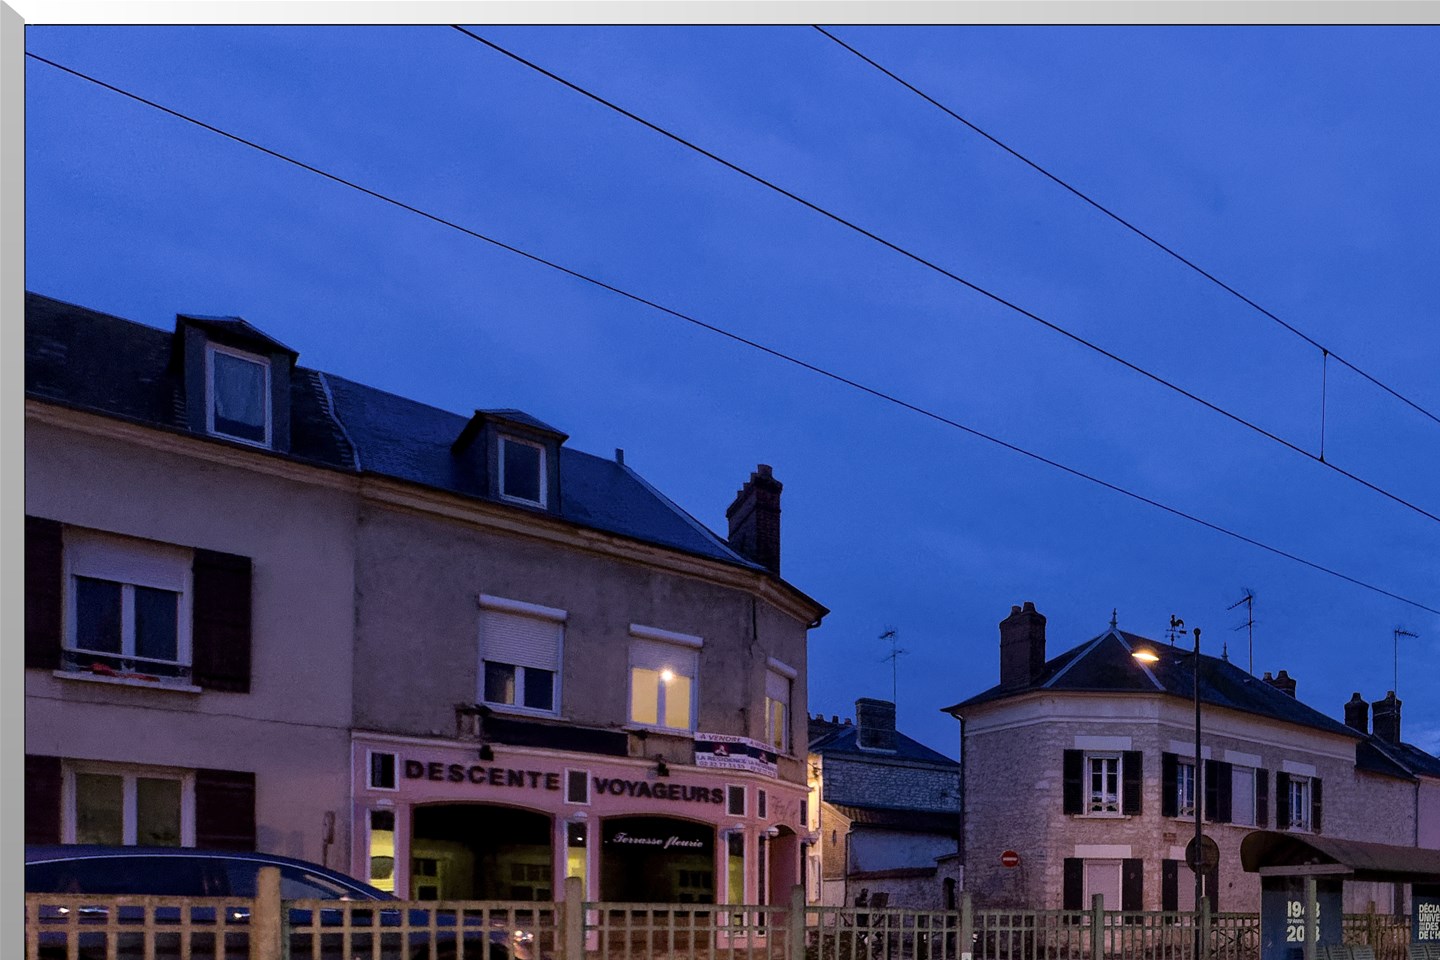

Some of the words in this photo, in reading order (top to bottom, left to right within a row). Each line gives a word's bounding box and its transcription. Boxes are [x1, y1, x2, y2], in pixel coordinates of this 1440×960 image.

[405, 759, 561, 791] DESCENTE
[592, 776, 725, 804] VOYAGEURS
[612, 831, 663, 846] Terrasse
[664, 834, 704, 850] fleurie
[1287, 900, 1320, 918] 198
[1286, 925, 1320, 942] 208
[1425, 922, 1439, 930] DES
[1419, 930, 1429, 940] DE
